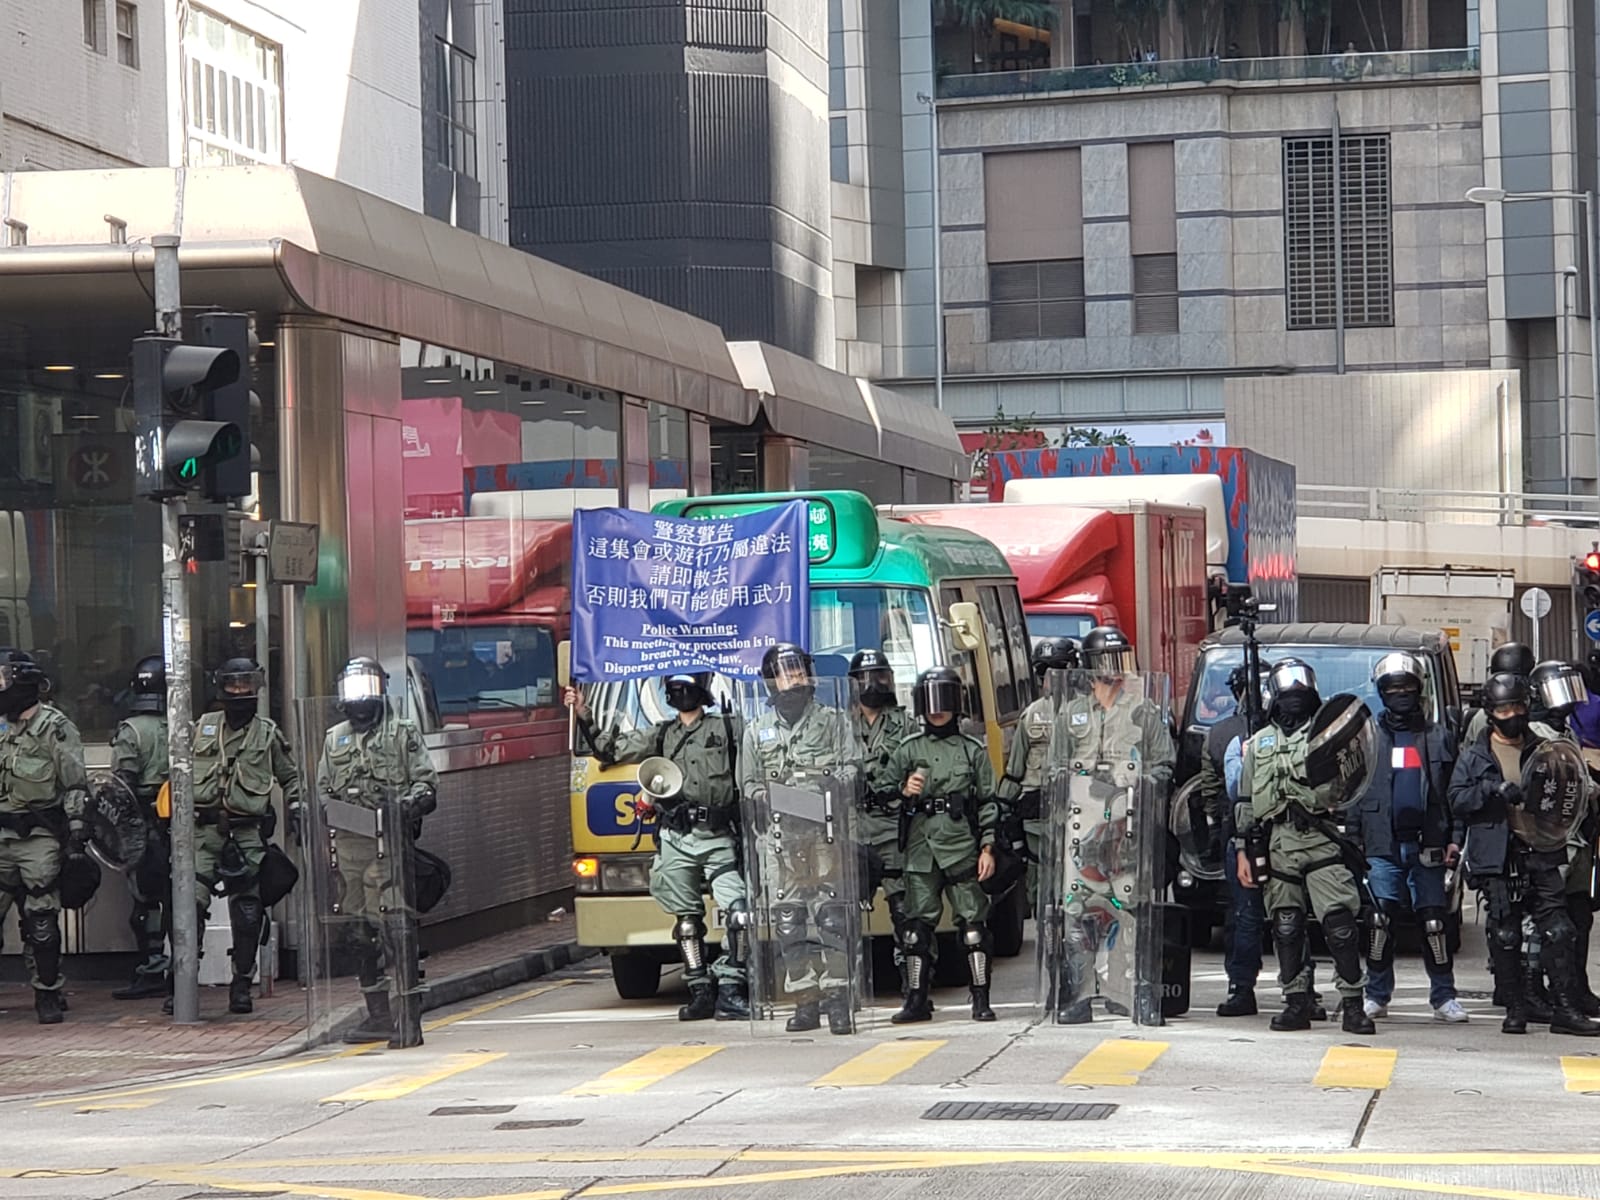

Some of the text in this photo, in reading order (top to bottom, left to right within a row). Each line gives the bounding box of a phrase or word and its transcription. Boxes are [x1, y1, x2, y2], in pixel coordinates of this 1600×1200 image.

[653, 520, 735, 545] 警察警告
[588, 533, 791, 567] 這集會或遊行乃屬違法
[650, 564, 729, 589] 請即散去
[586, 582, 792, 612] 否則我們可能使用武力
[642, 623, 738, 636] Police Warning:
[603, 636, 629, 648] This
[679, 642, 692, 650] or
[694, 638, 750, 653] procession
[753, 637, 762, 647] is
[764, 635, 776, 646] in
[641, 648, 680, 661] breach
[718, 653, 742, 664] law.
[604, 662, 655, 676] Disperse
[657, 661, 671, 669] or
[673, 659, 689, 667] we
[742, 664, 760, 675] for
[1562, 781, 1577, 815] POLICE
